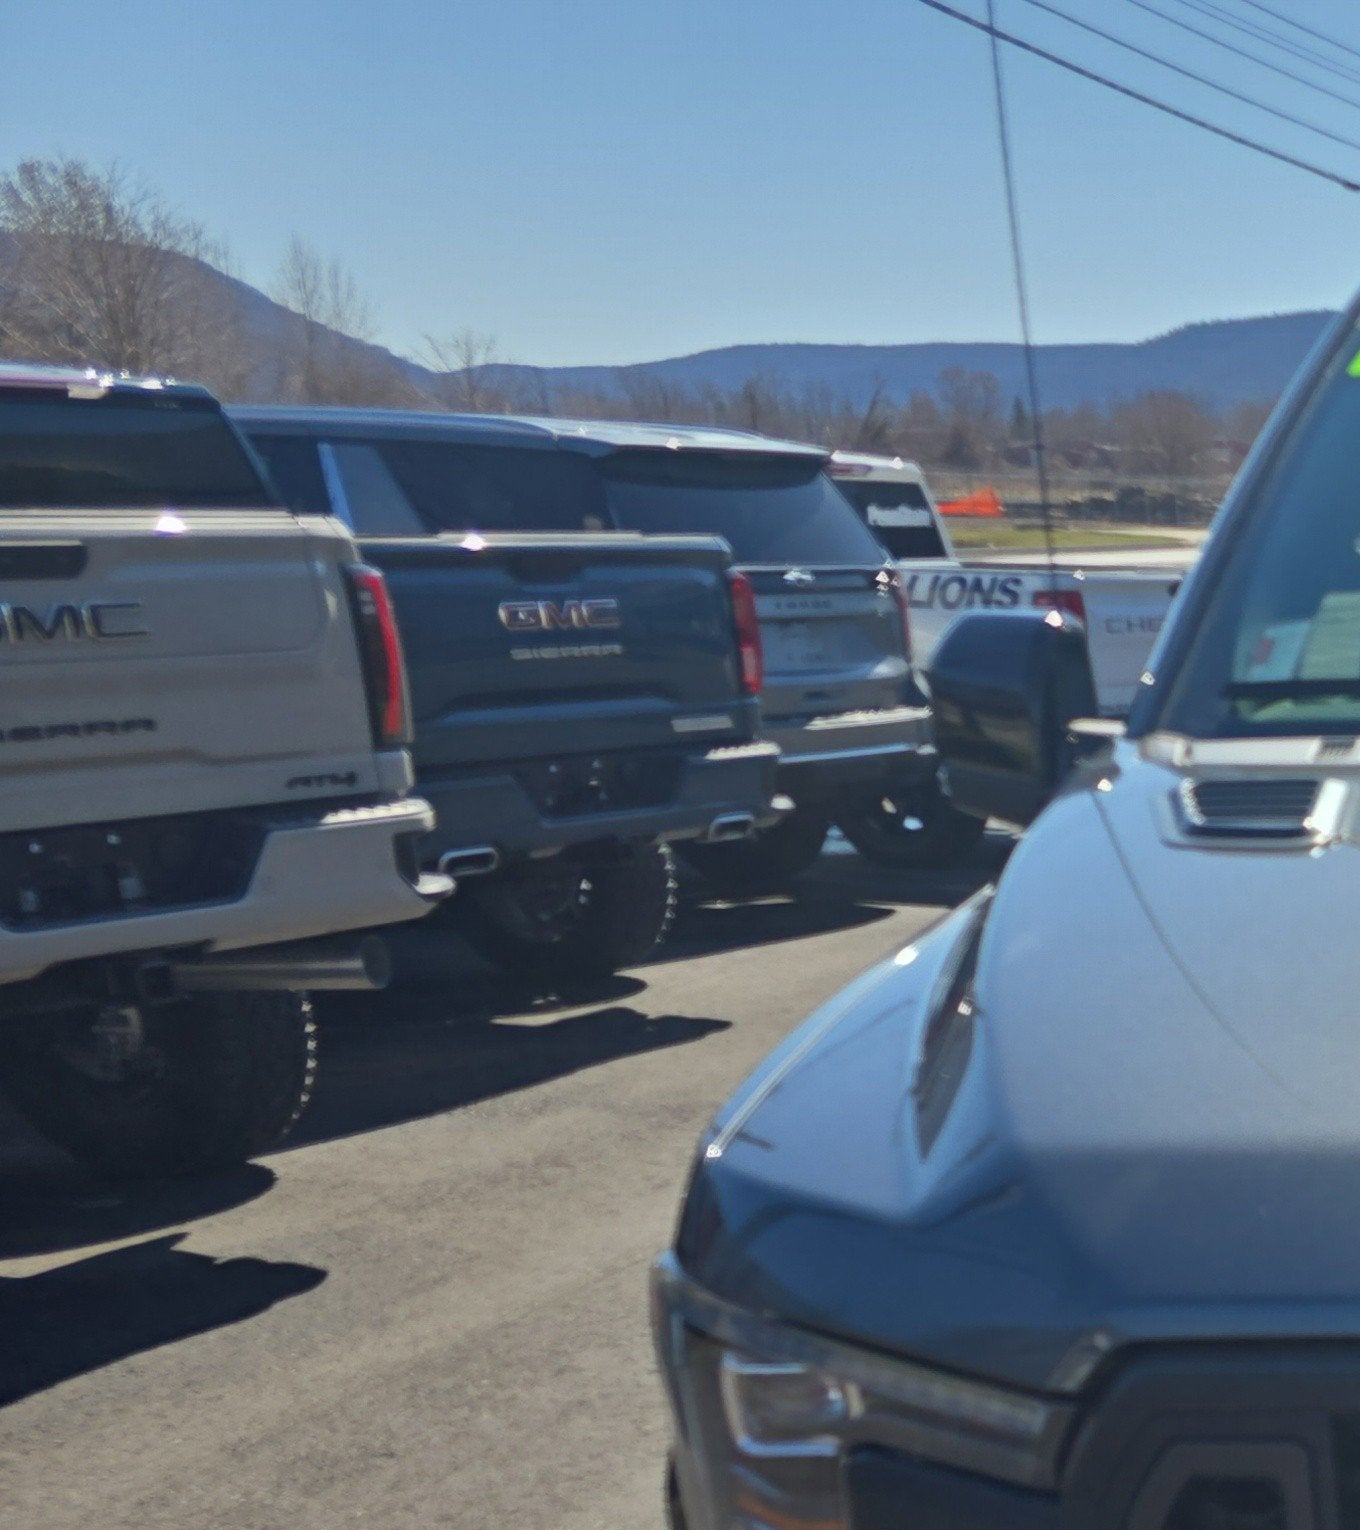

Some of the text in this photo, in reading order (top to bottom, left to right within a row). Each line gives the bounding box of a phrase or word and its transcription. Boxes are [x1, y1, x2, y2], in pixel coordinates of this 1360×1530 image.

[906, 573, 1023, 609] LIONS
[0, 602, 150, 643] MC
[498, 598, 620, 631] GMC
